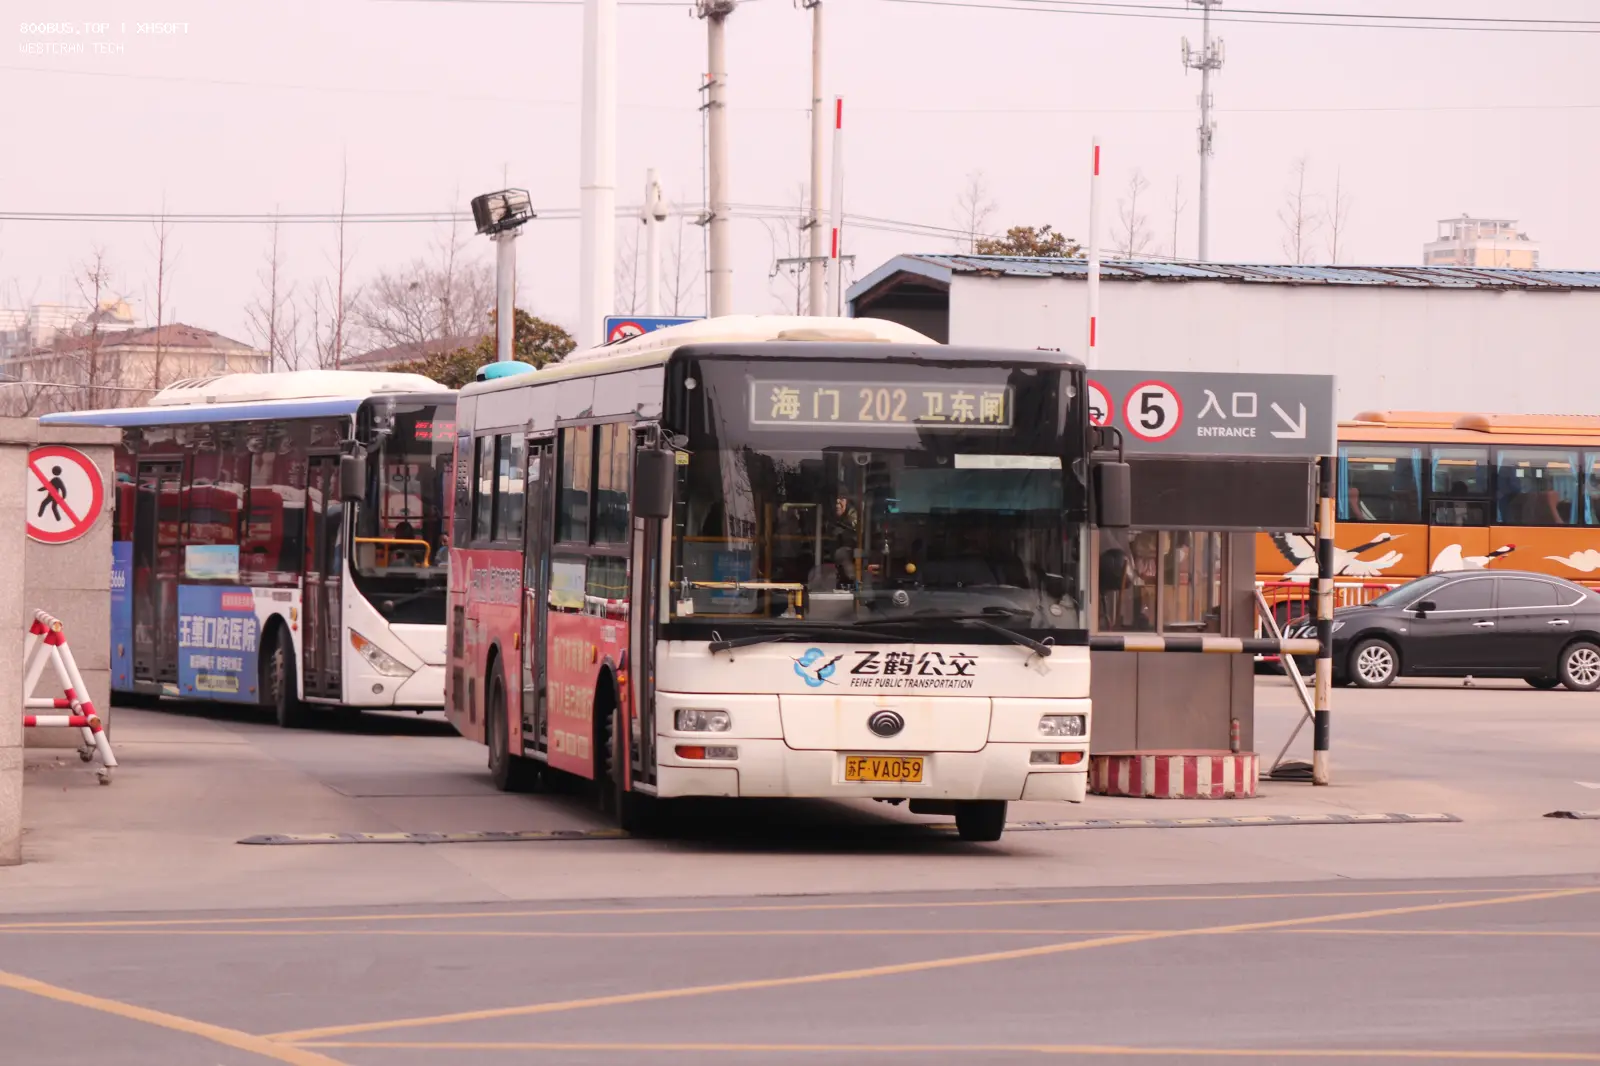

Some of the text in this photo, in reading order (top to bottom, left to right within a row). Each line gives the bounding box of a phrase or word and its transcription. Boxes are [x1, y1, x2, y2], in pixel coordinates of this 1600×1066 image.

[770, 386, 1005, 424] 海门 202 卫东闸
[1140, 392, 1166, 430] 5
[1197, 389, 1258, 420] 入口
[1196, 426, 1257, 438] ENTRANCE
[850, 650, 979, 677] 飞鹤公交
[850, 677, 974, 690] FEIHE PUBLIC TRANSPORTATION
